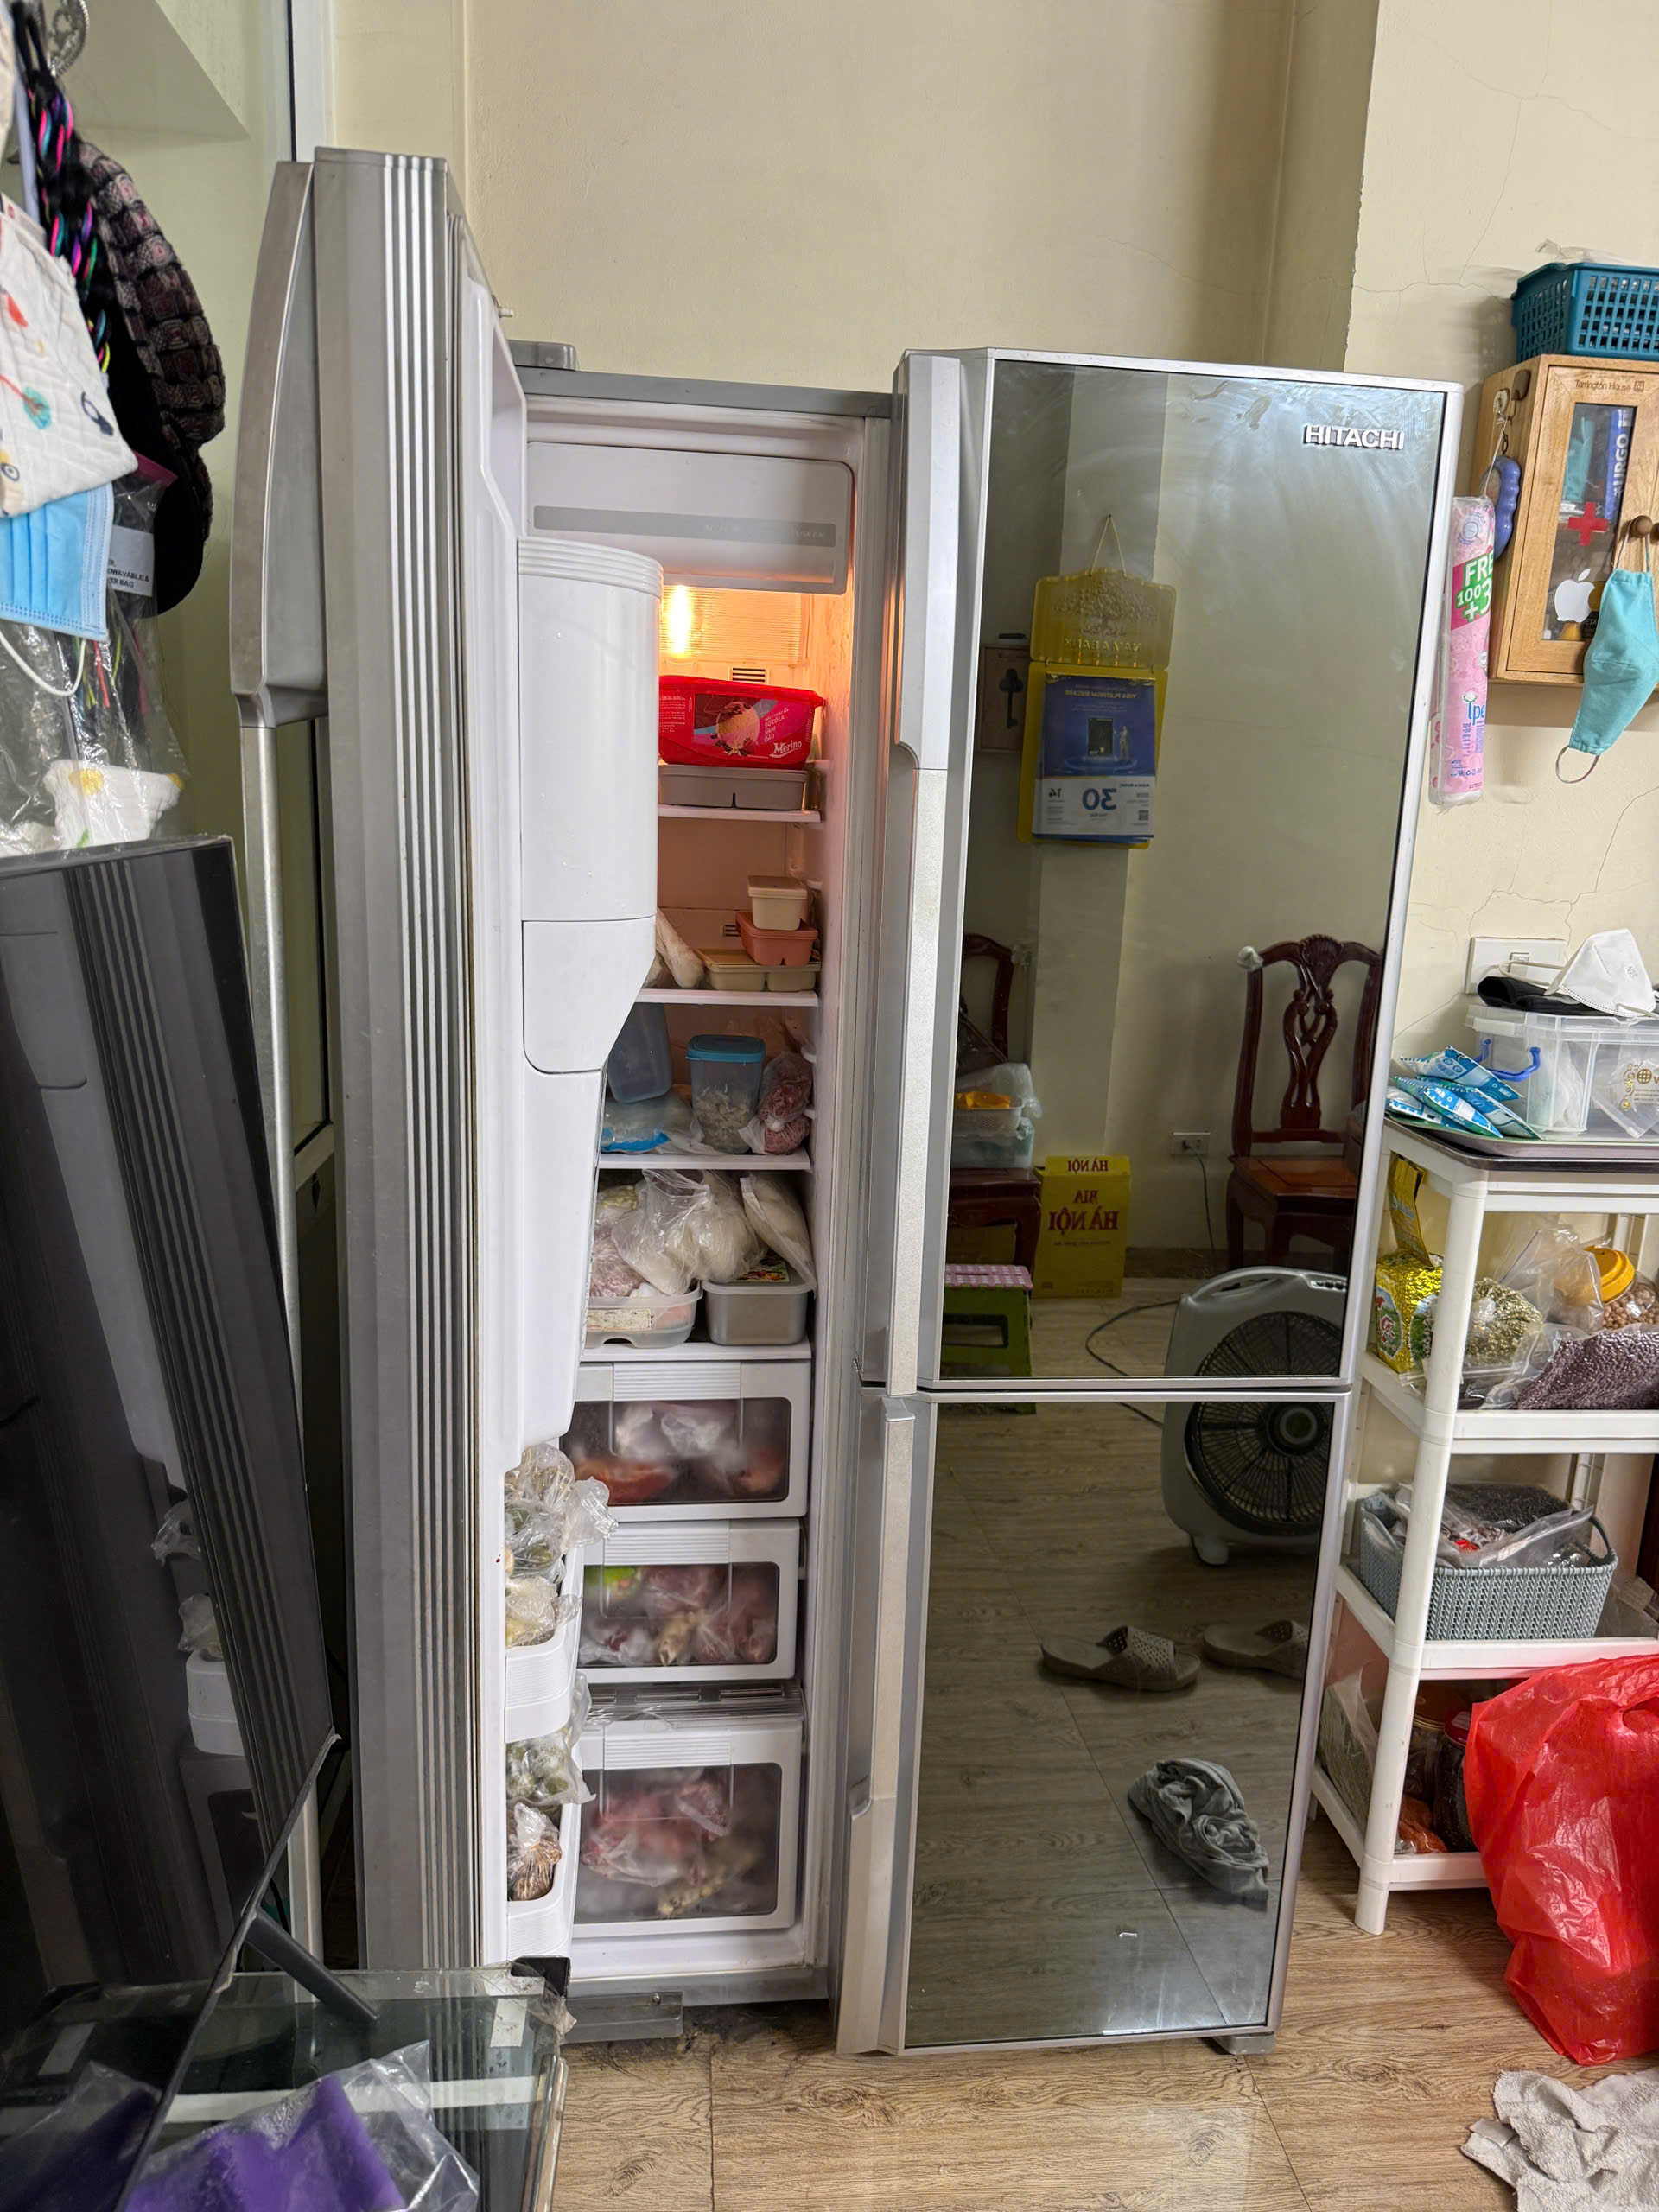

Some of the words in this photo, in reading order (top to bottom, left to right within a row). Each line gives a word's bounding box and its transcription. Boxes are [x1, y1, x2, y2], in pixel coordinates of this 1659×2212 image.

[1609, 380, 1631, 391] House
[1303, 424, 1404, 449] HITACHI
[1613, 433, 1629, 486] URGO
[1465, 550, 1494, 587] FRE
[119, 579, 135, 588] BAG
[1457, 583, 1482, 607] 100
[1464, 577, 1493, 620] +3
[772, 740, 803, 755] Merino
